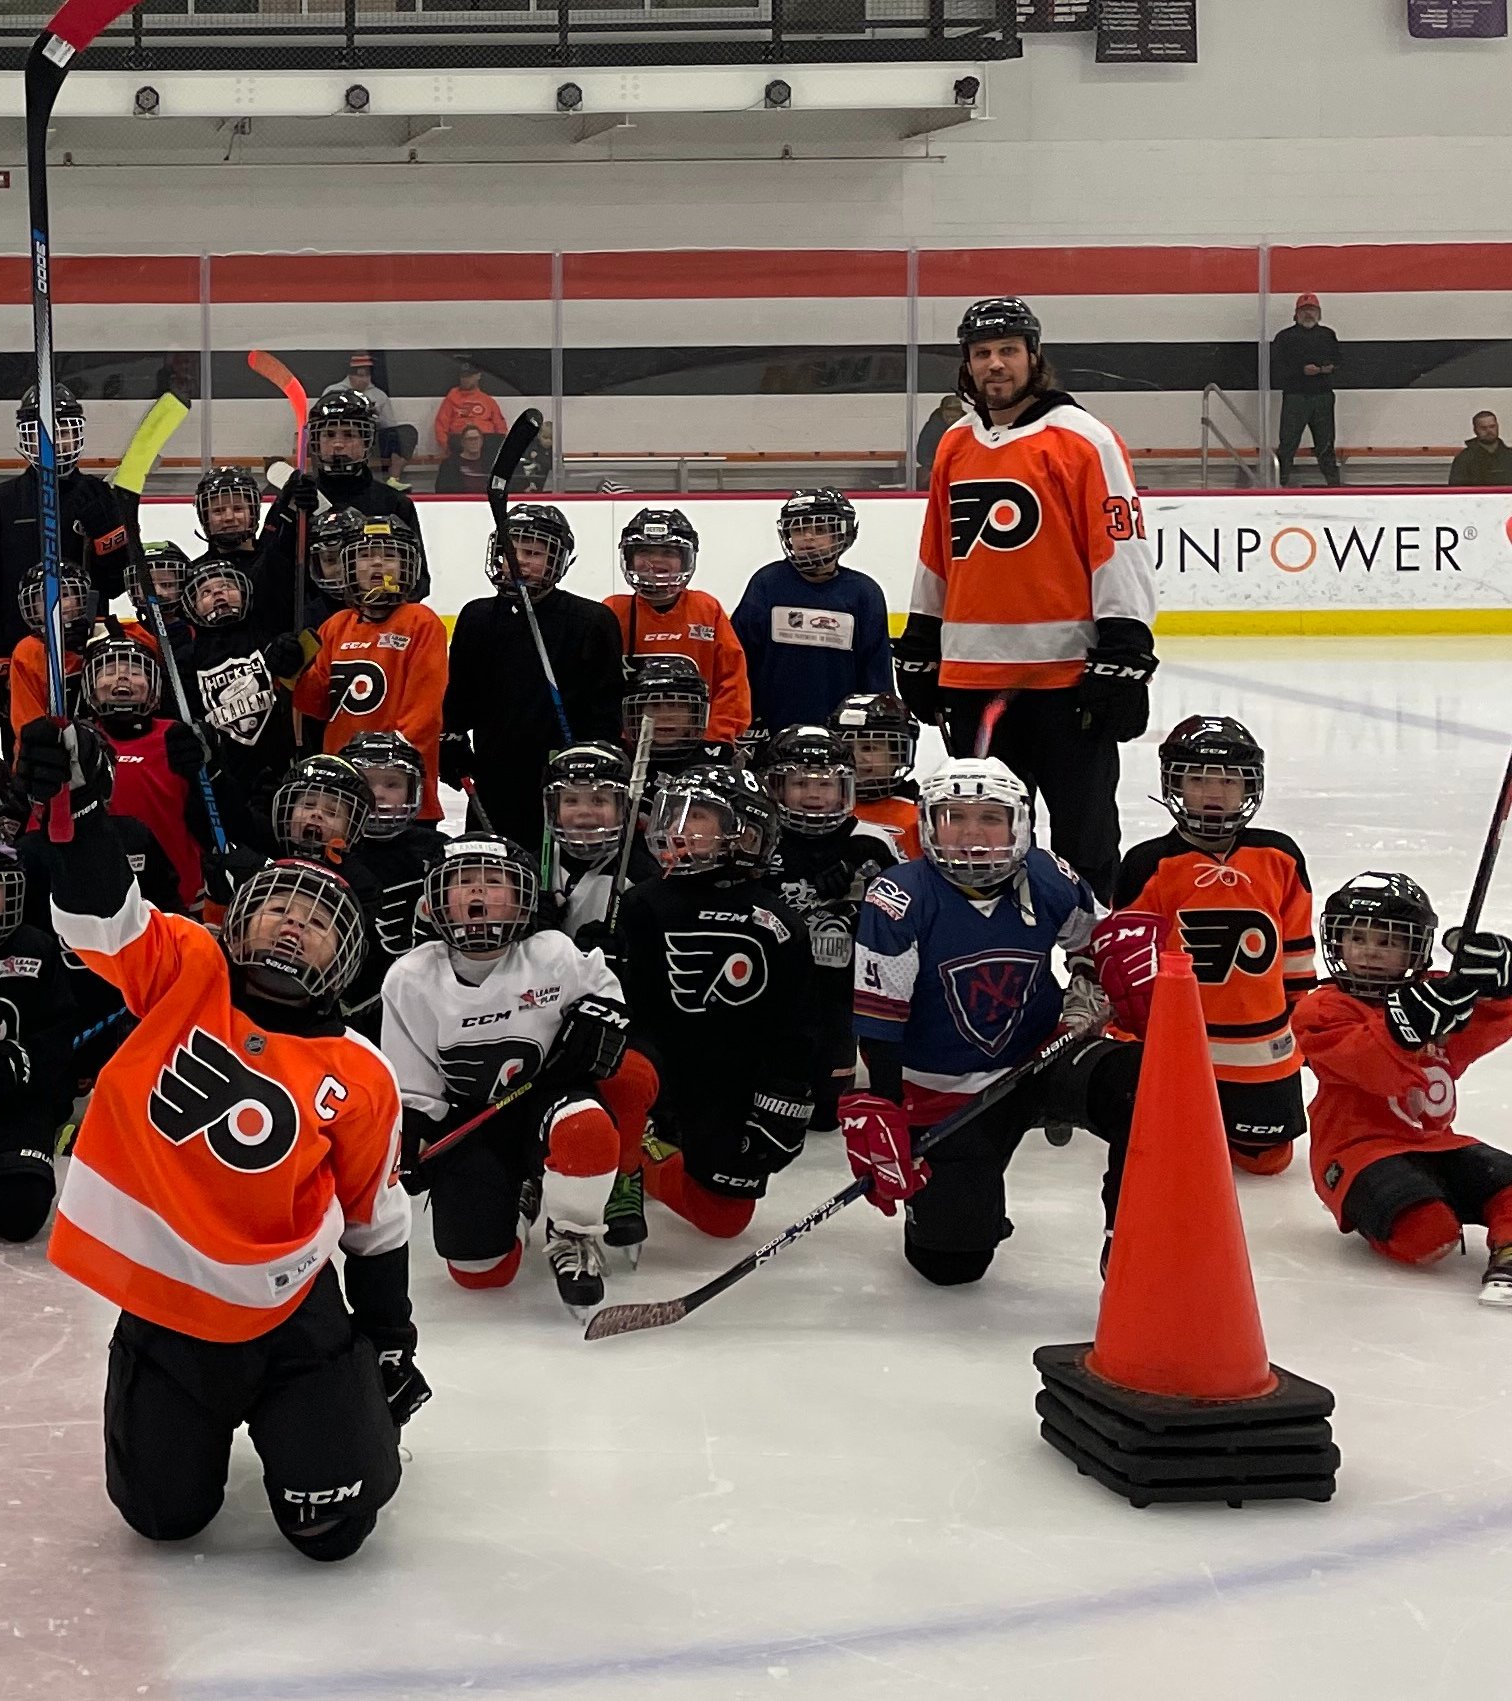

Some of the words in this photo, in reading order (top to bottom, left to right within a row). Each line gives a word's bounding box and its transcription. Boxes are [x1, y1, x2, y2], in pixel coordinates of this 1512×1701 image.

[340, 641, 372, 650] CCM
[643, 633, 682, 642] CCM
[204, 661, 263, 692] HOCKEY
[212, 690, 273, 726] ACADEMY
[745, 804, 769, 819] CCM
[1351, 899, 1381, 907] CCM
[698, 909, 749, 924] CCM
[264, 957, 298, 975] BAUER
[535, 985, 561, 998] LEARN
[539, 993, 560, 1005] PLAY
[461, 1009, 513, 1028] CCM
[314, 1074, 348, 1121] C
[1235, 1123, 1285, 1135] CCM
[712, 1172, 760, 1189] CCM
[795, 1198, 835, 1227] NEXUS
[755, 1202, 845, 1269] NEXUS
[284, 1479, 363, 1505] CCM
